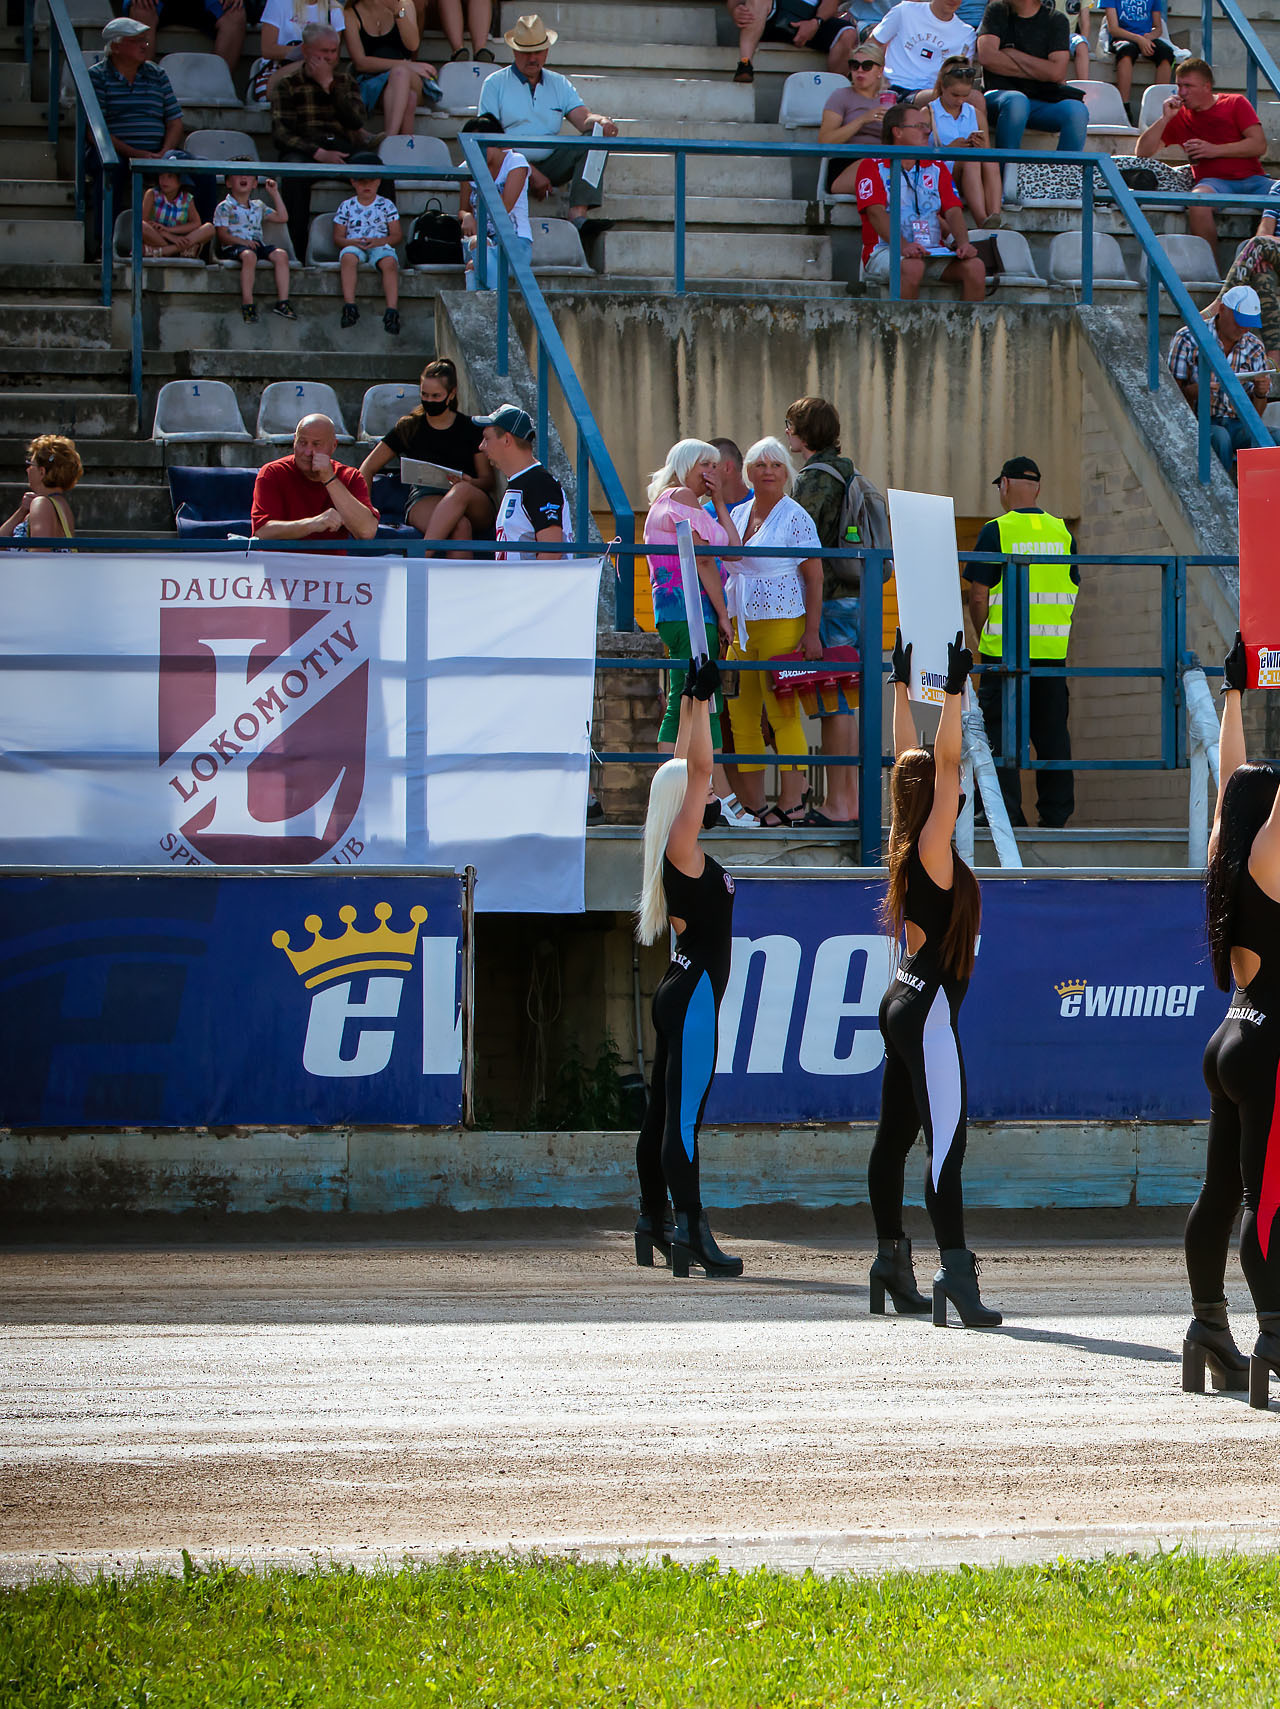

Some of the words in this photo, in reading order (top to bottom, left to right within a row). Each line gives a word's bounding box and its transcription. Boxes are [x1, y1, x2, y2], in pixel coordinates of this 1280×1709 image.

[472, 67, 480, 77] 5
[814, 75, 821, 85] 6
[407, 139, 415, 150] 4
[541, 223, 549, 234] 5
[193, 386, 202, 397] 1
[296, 386, 305, 397] 2
[160, 577, 374, 606] DAUGAVPILS
[168, 620, 360, 803] LOKOMOTIV
[1060, 985, 1205, 1017] ewinner
